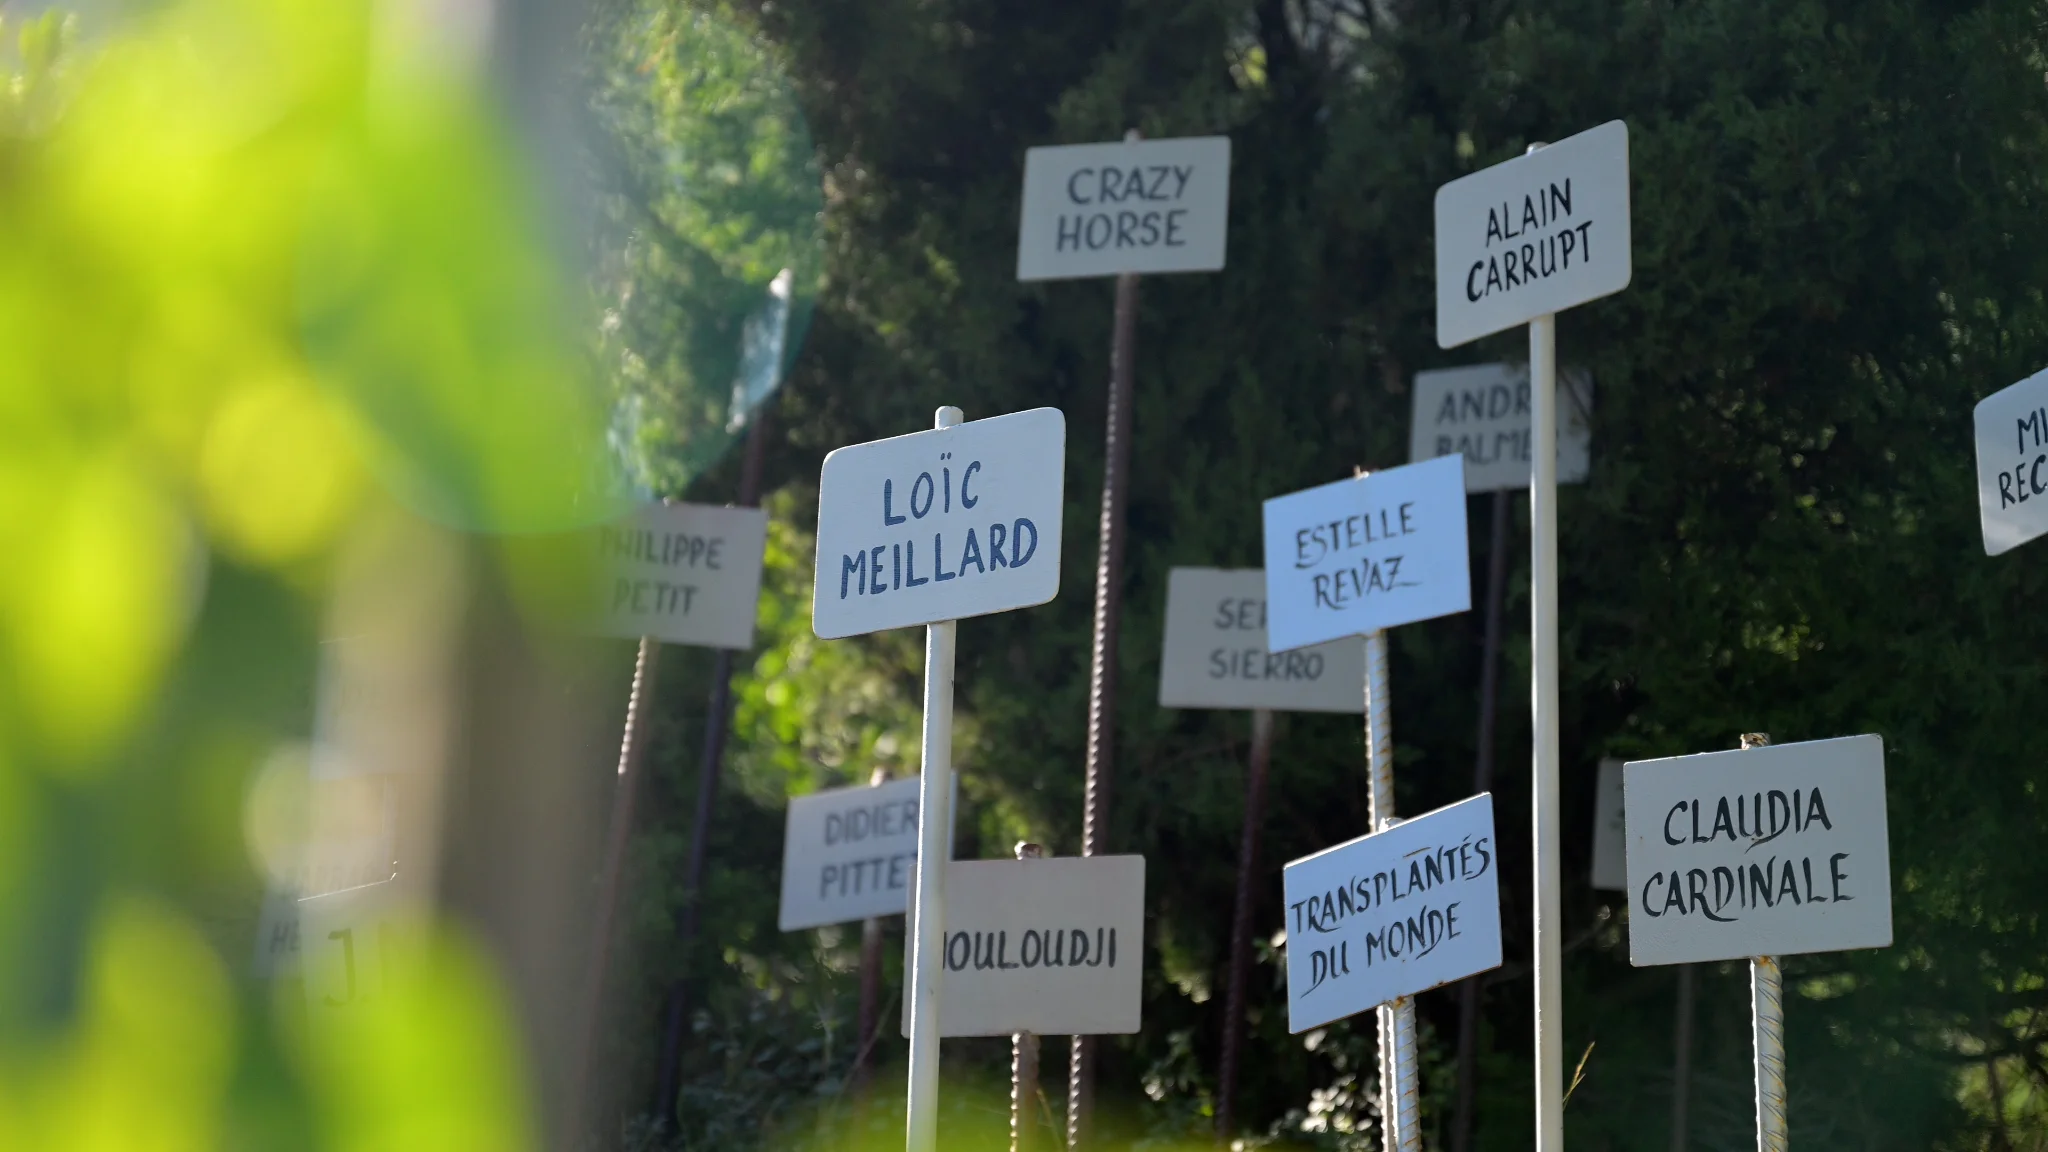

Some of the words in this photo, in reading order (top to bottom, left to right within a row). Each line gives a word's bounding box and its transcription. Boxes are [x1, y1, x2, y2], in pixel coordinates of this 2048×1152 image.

[1067, 165, 1194, 205] CRAZY
[1056, 209, 1189, 252] HORSE
[1486, 177, 1572, 248] ALAIN
[1467, 220, 1593, 302] CARRUPT
[1435, 379, 1531, 426] ANDR
[1436, 428, 1560, 466] BALME
[884, 452, 981, 526] LOÏC
[840, 518, 1038, 600] MEILLARD
[1294, 502, 1419, 569] ESTELLE
[612, 577, 699, 618] PETIT
[1313, 555, 1423, 610] REVAZ
[1213, 596, 1267, 630] SE
[1208, 647, 1325, 681] SIERRO
[824, 799, 919, 847] DIDIER
[1664, 786, 1833, 854] CLAUDIA
[820, 852, 918, 900] PITTE
[1291, 833, 1492, 934] TRANSPLANTÉS
[1642, 852, 1856, 922] CARDINALE
[943, 927, 1117, 973] OULOUDJI
[1300, 941, 1350, 999] DU
[1366, 901, 1463, 968] MONDE
